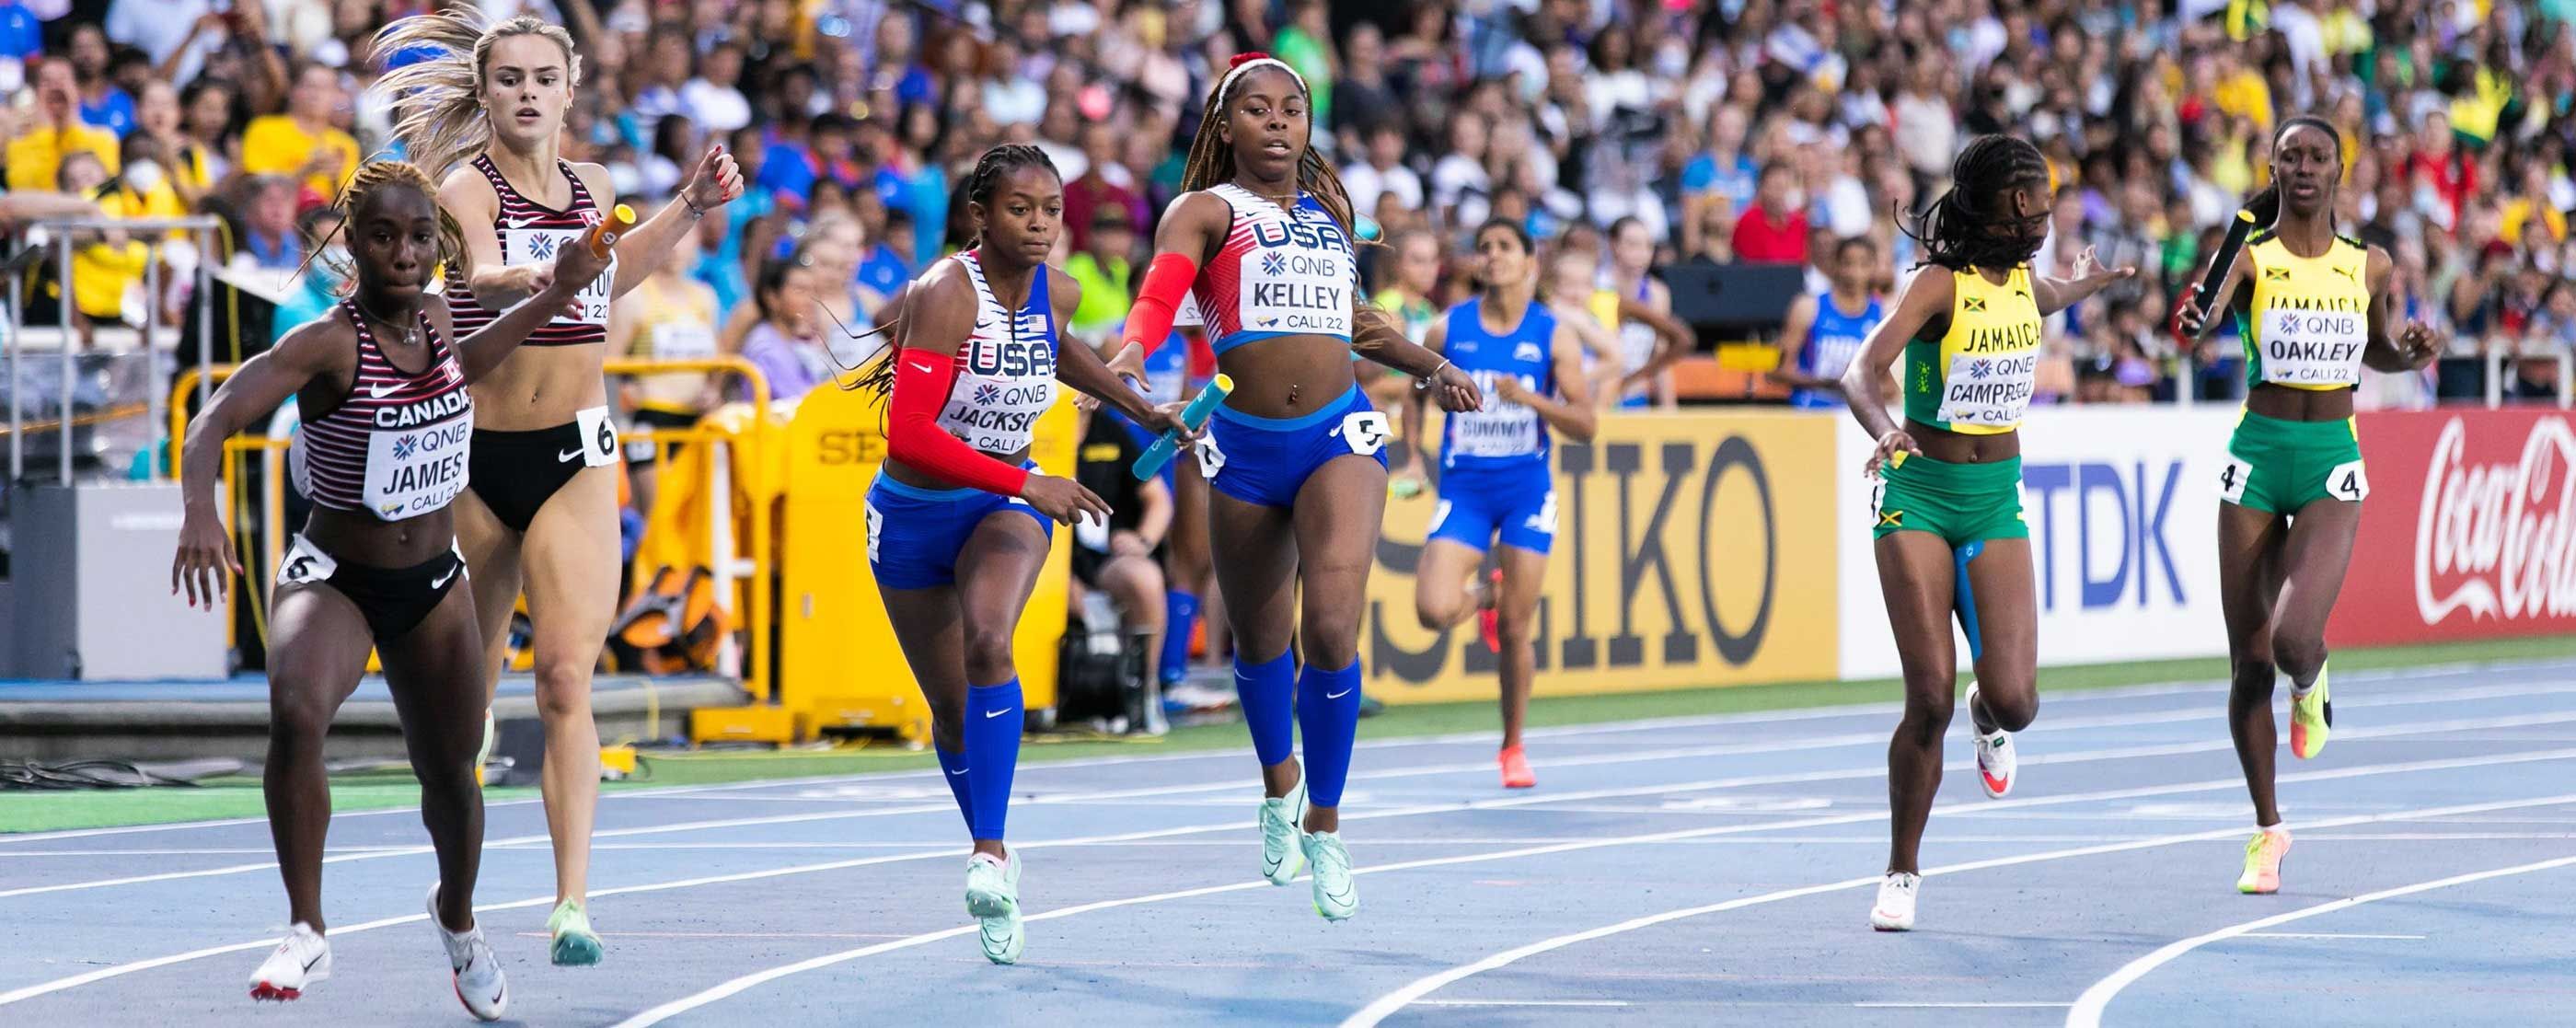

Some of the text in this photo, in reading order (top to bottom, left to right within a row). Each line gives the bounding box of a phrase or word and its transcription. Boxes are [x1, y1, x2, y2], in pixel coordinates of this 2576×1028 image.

[1253, 220, 1347, 254] USA
[1290, 255, 1336, 277] QNB
[1253, 283, 1341, 310] KELLEY
[1287, 315, 1345, 329] CALI 22
[2305, 317, 2355, 335] QNB
[969, 341, 1052, 377] USA
[2270, 340, 2359, 361] OAKLEY
[2300, 368, 2350, 380] CALI 22
[375, 387, 471, 428] CANADA
[1003, 384, 1048, 406] QNB
[421, 422, 468, 453] QNB
[596, 415, 615, 457] 6
[978, 436, 1016, 452] CALI
[1358, 419, 1382, 446] 5
[382, 451, 464, 495] JAMES
[2220, 463, 2236, 492] 4
[2339, 469, 2360, 499] 4
[411, 491, 445, 512] CALI
[2021, 462, 2187, 609] TDK
[286, 555, 318, 581] 6
